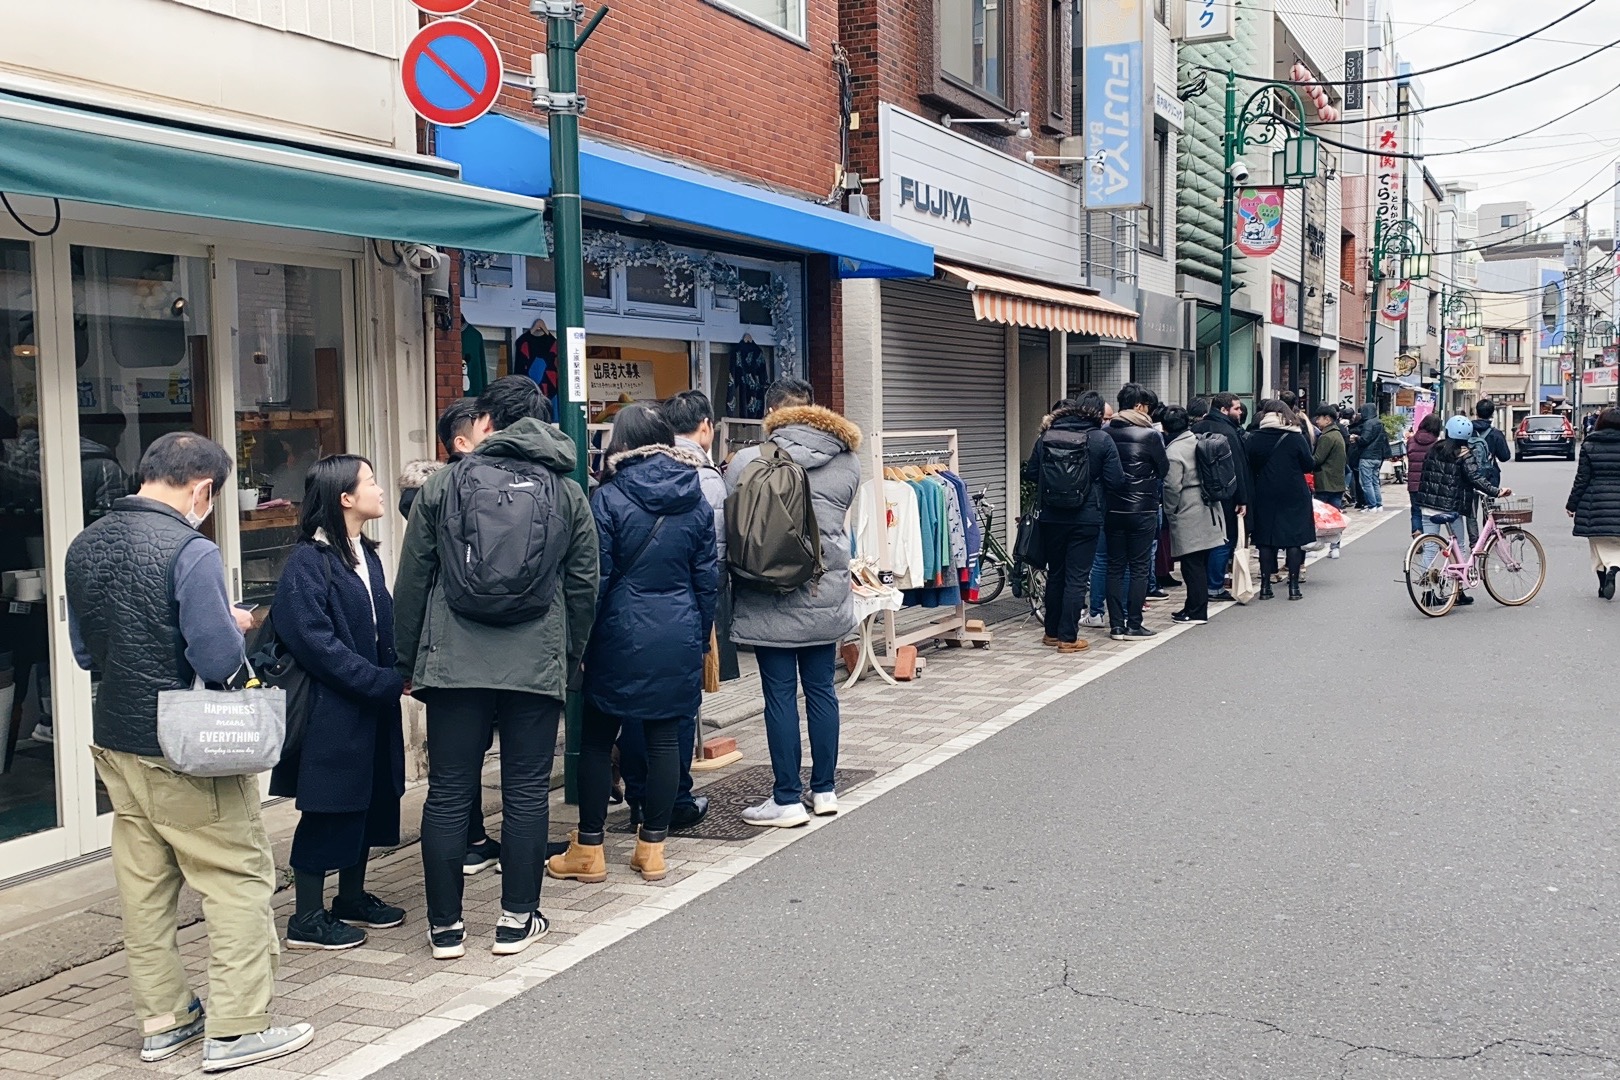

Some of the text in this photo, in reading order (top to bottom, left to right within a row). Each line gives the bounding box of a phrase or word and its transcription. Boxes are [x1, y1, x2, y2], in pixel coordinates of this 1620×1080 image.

[1346, 57, 1355, 104] SMILE
[1104, 52, 1130, 196] FUJIYA
[1089, 121, 1104, 201] BARY
[900, 176, 972, 226] FUJIYA
[1339, 367, 1354, 393] 焼肉
[204, 703, 255, 714] HAPPINESS
[200, 731, 260, 742] EVERYTHING
